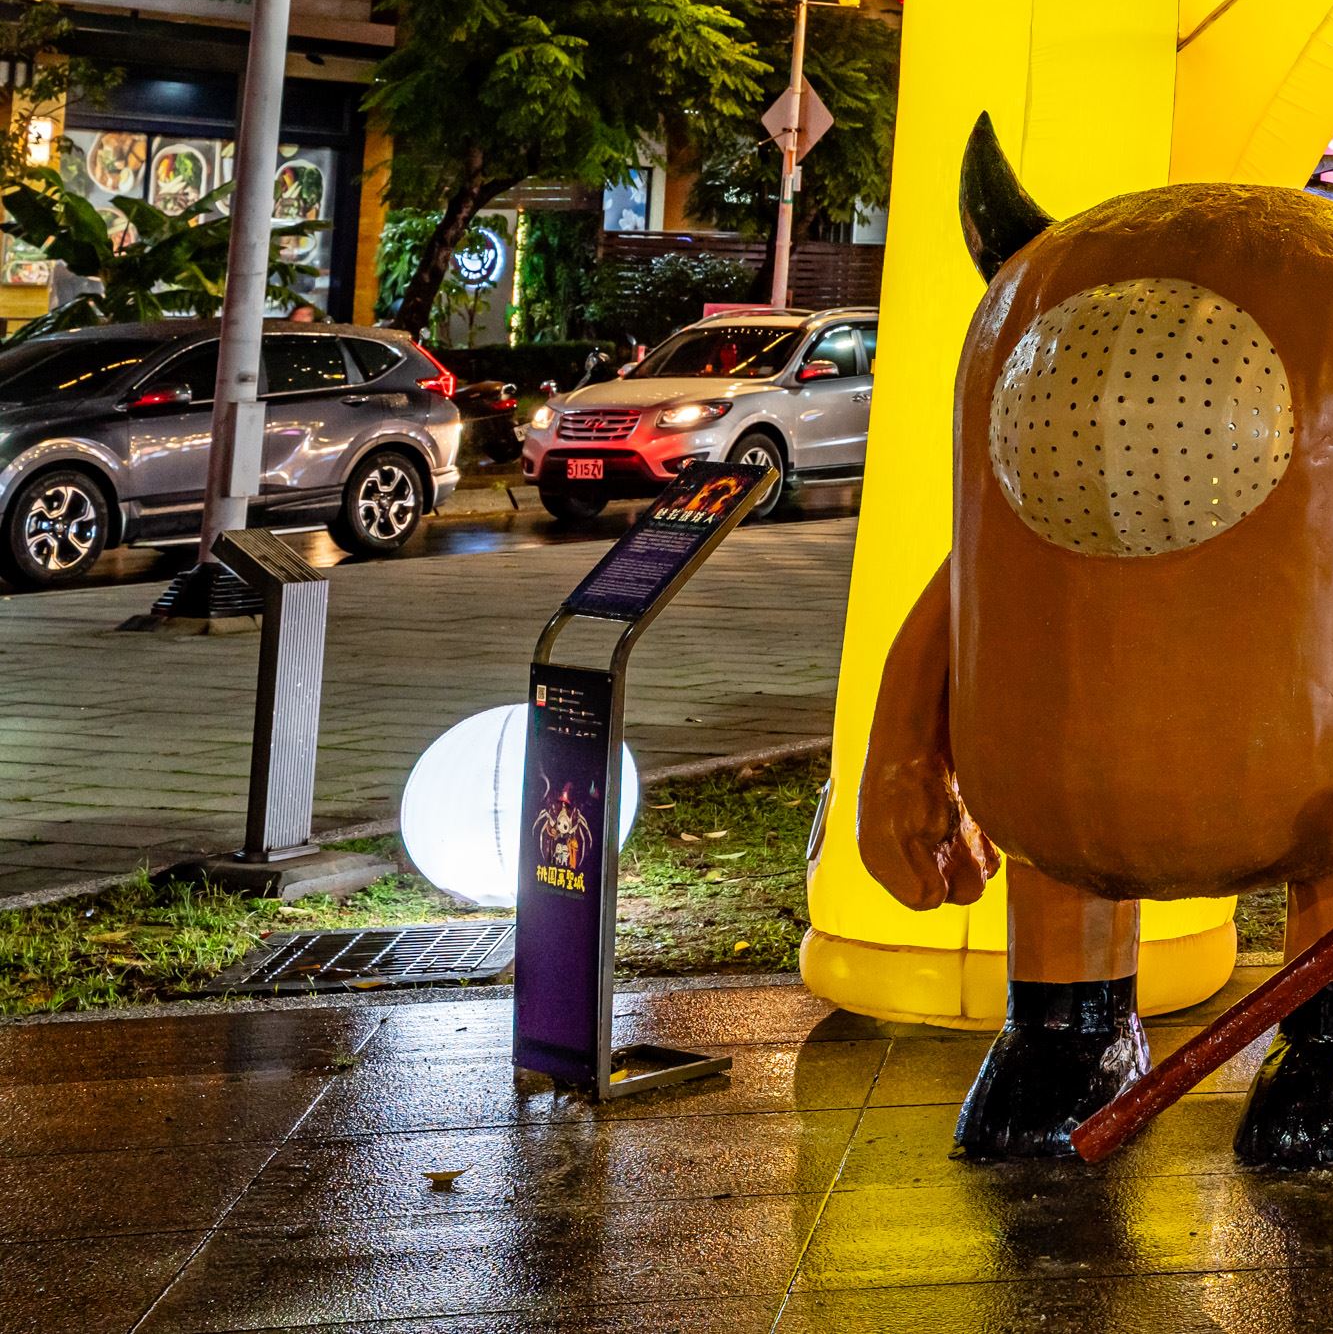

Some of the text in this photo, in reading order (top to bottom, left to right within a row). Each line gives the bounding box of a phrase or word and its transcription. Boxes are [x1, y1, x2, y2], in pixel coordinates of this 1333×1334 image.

[537, 865, 585, 892] 桃園萬聖城
